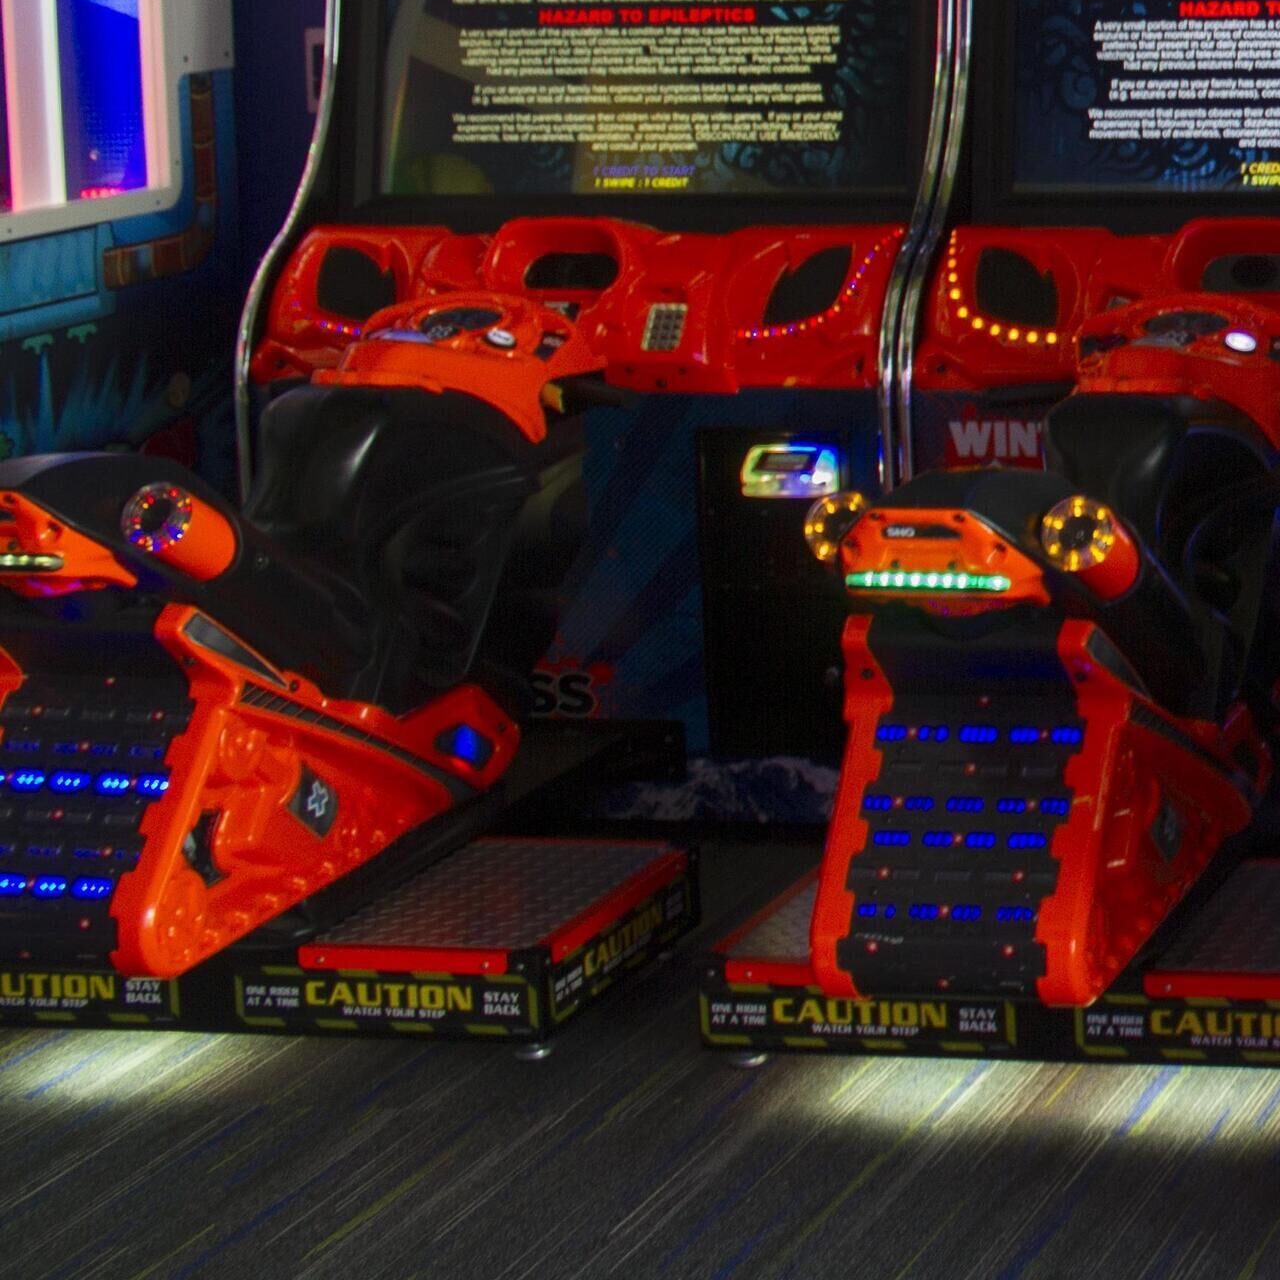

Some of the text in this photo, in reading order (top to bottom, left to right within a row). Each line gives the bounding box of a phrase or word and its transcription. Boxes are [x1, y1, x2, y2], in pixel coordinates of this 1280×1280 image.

[538, 7, 756, 26] HAZARD TO EPILEPTICS
[1179, 0, 1260, 17] HAZARD
[948, 419, 1042, 458] WIN
[584, 902, 663, 979] CAUTION
[0, 972, 115, 1000] UTION
[125, 979, 161, 1006] STAY BACK
[305, 978, 473, 1012] CAUTION
[246, 996, 263, 1007] AT
[343, 1006, 447, 1019] WATCH YOUR STEP
[483, 991, 521, 1017] STAY BACK
[711, 1014, 727, 1026] AT
[771, 997, 948, 1030] CAUTION
[958, 1006, 998, 1034] STAY BACK
[812, 1023, 920, 1037] WATCH YOUR STEP
[1086, 1024, 1104, 1036] AT
[1190, 1035, 1233, 1048] WATCH
[1236, 1036, 1269, 1049] YOUR
